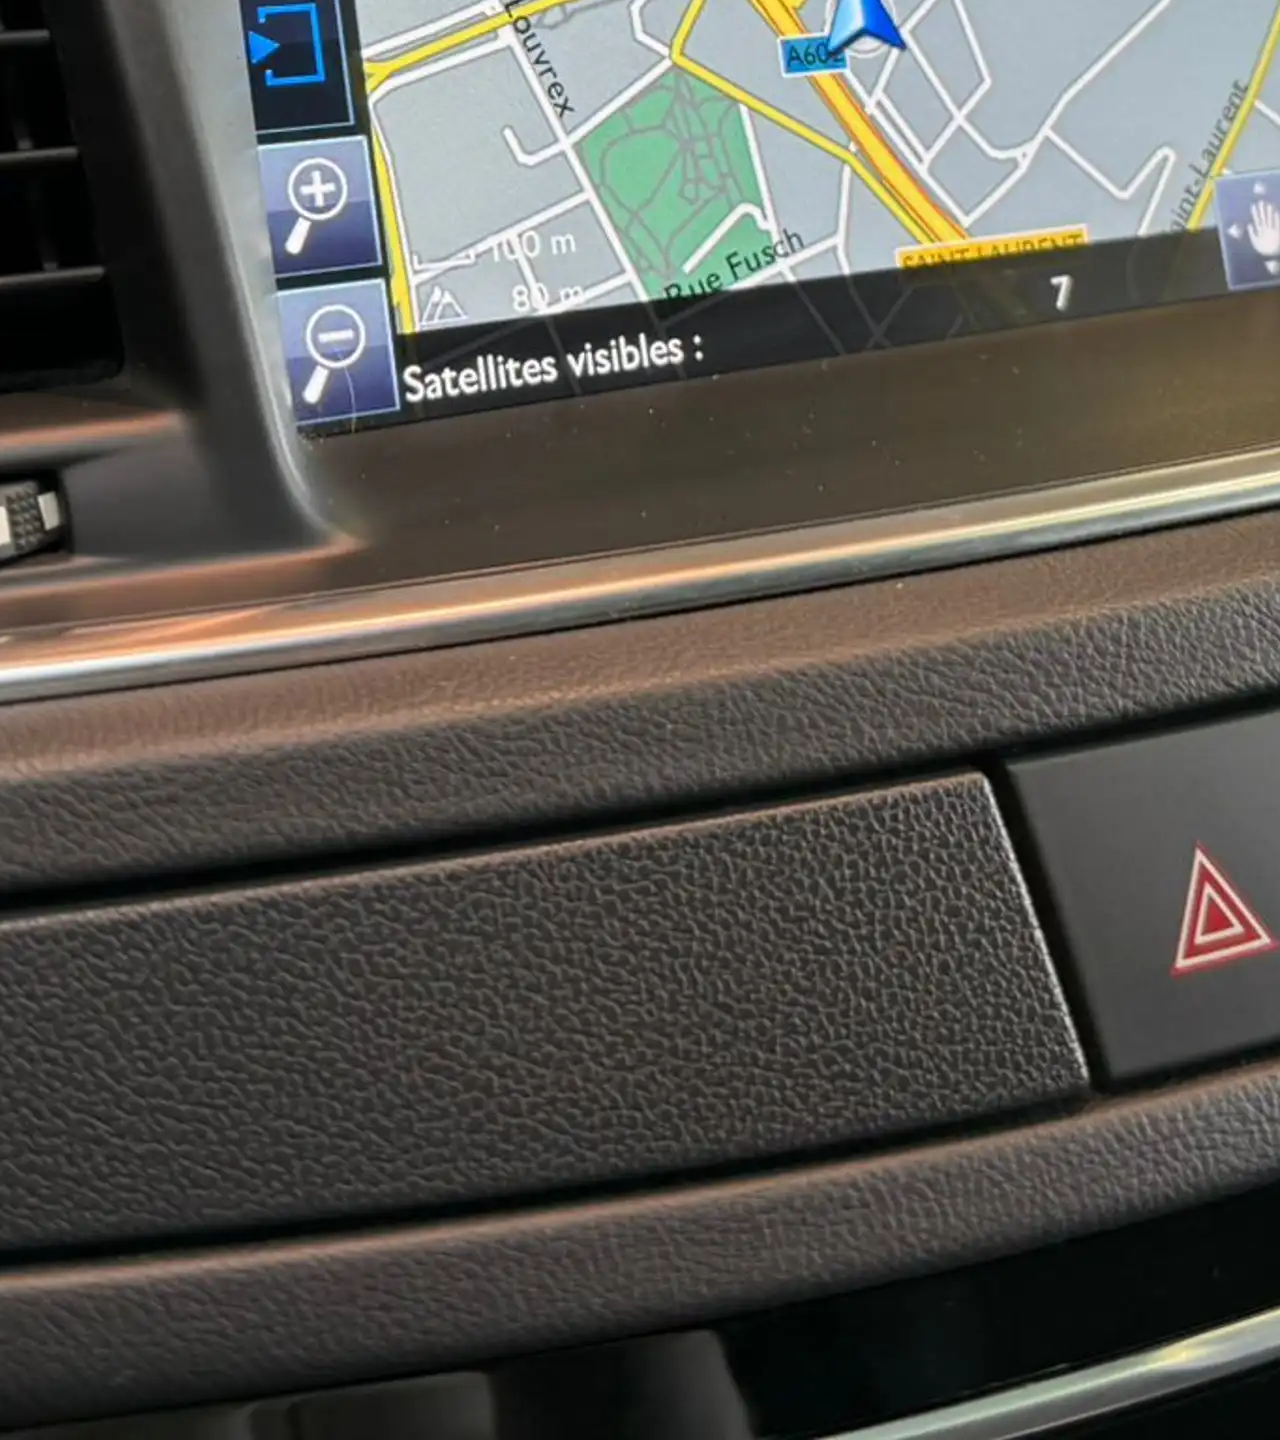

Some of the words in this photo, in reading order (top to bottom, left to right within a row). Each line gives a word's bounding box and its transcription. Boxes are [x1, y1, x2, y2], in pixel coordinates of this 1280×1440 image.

[786, 41, 844, 67] A60
[550, 232, 577, 255] m
[724, 227, 805, 280] Fusch
[1049, 274, 1074, 311] 7
[403, 353, 559, 403] Satellites
[566, 332, 684, 378] visibles
